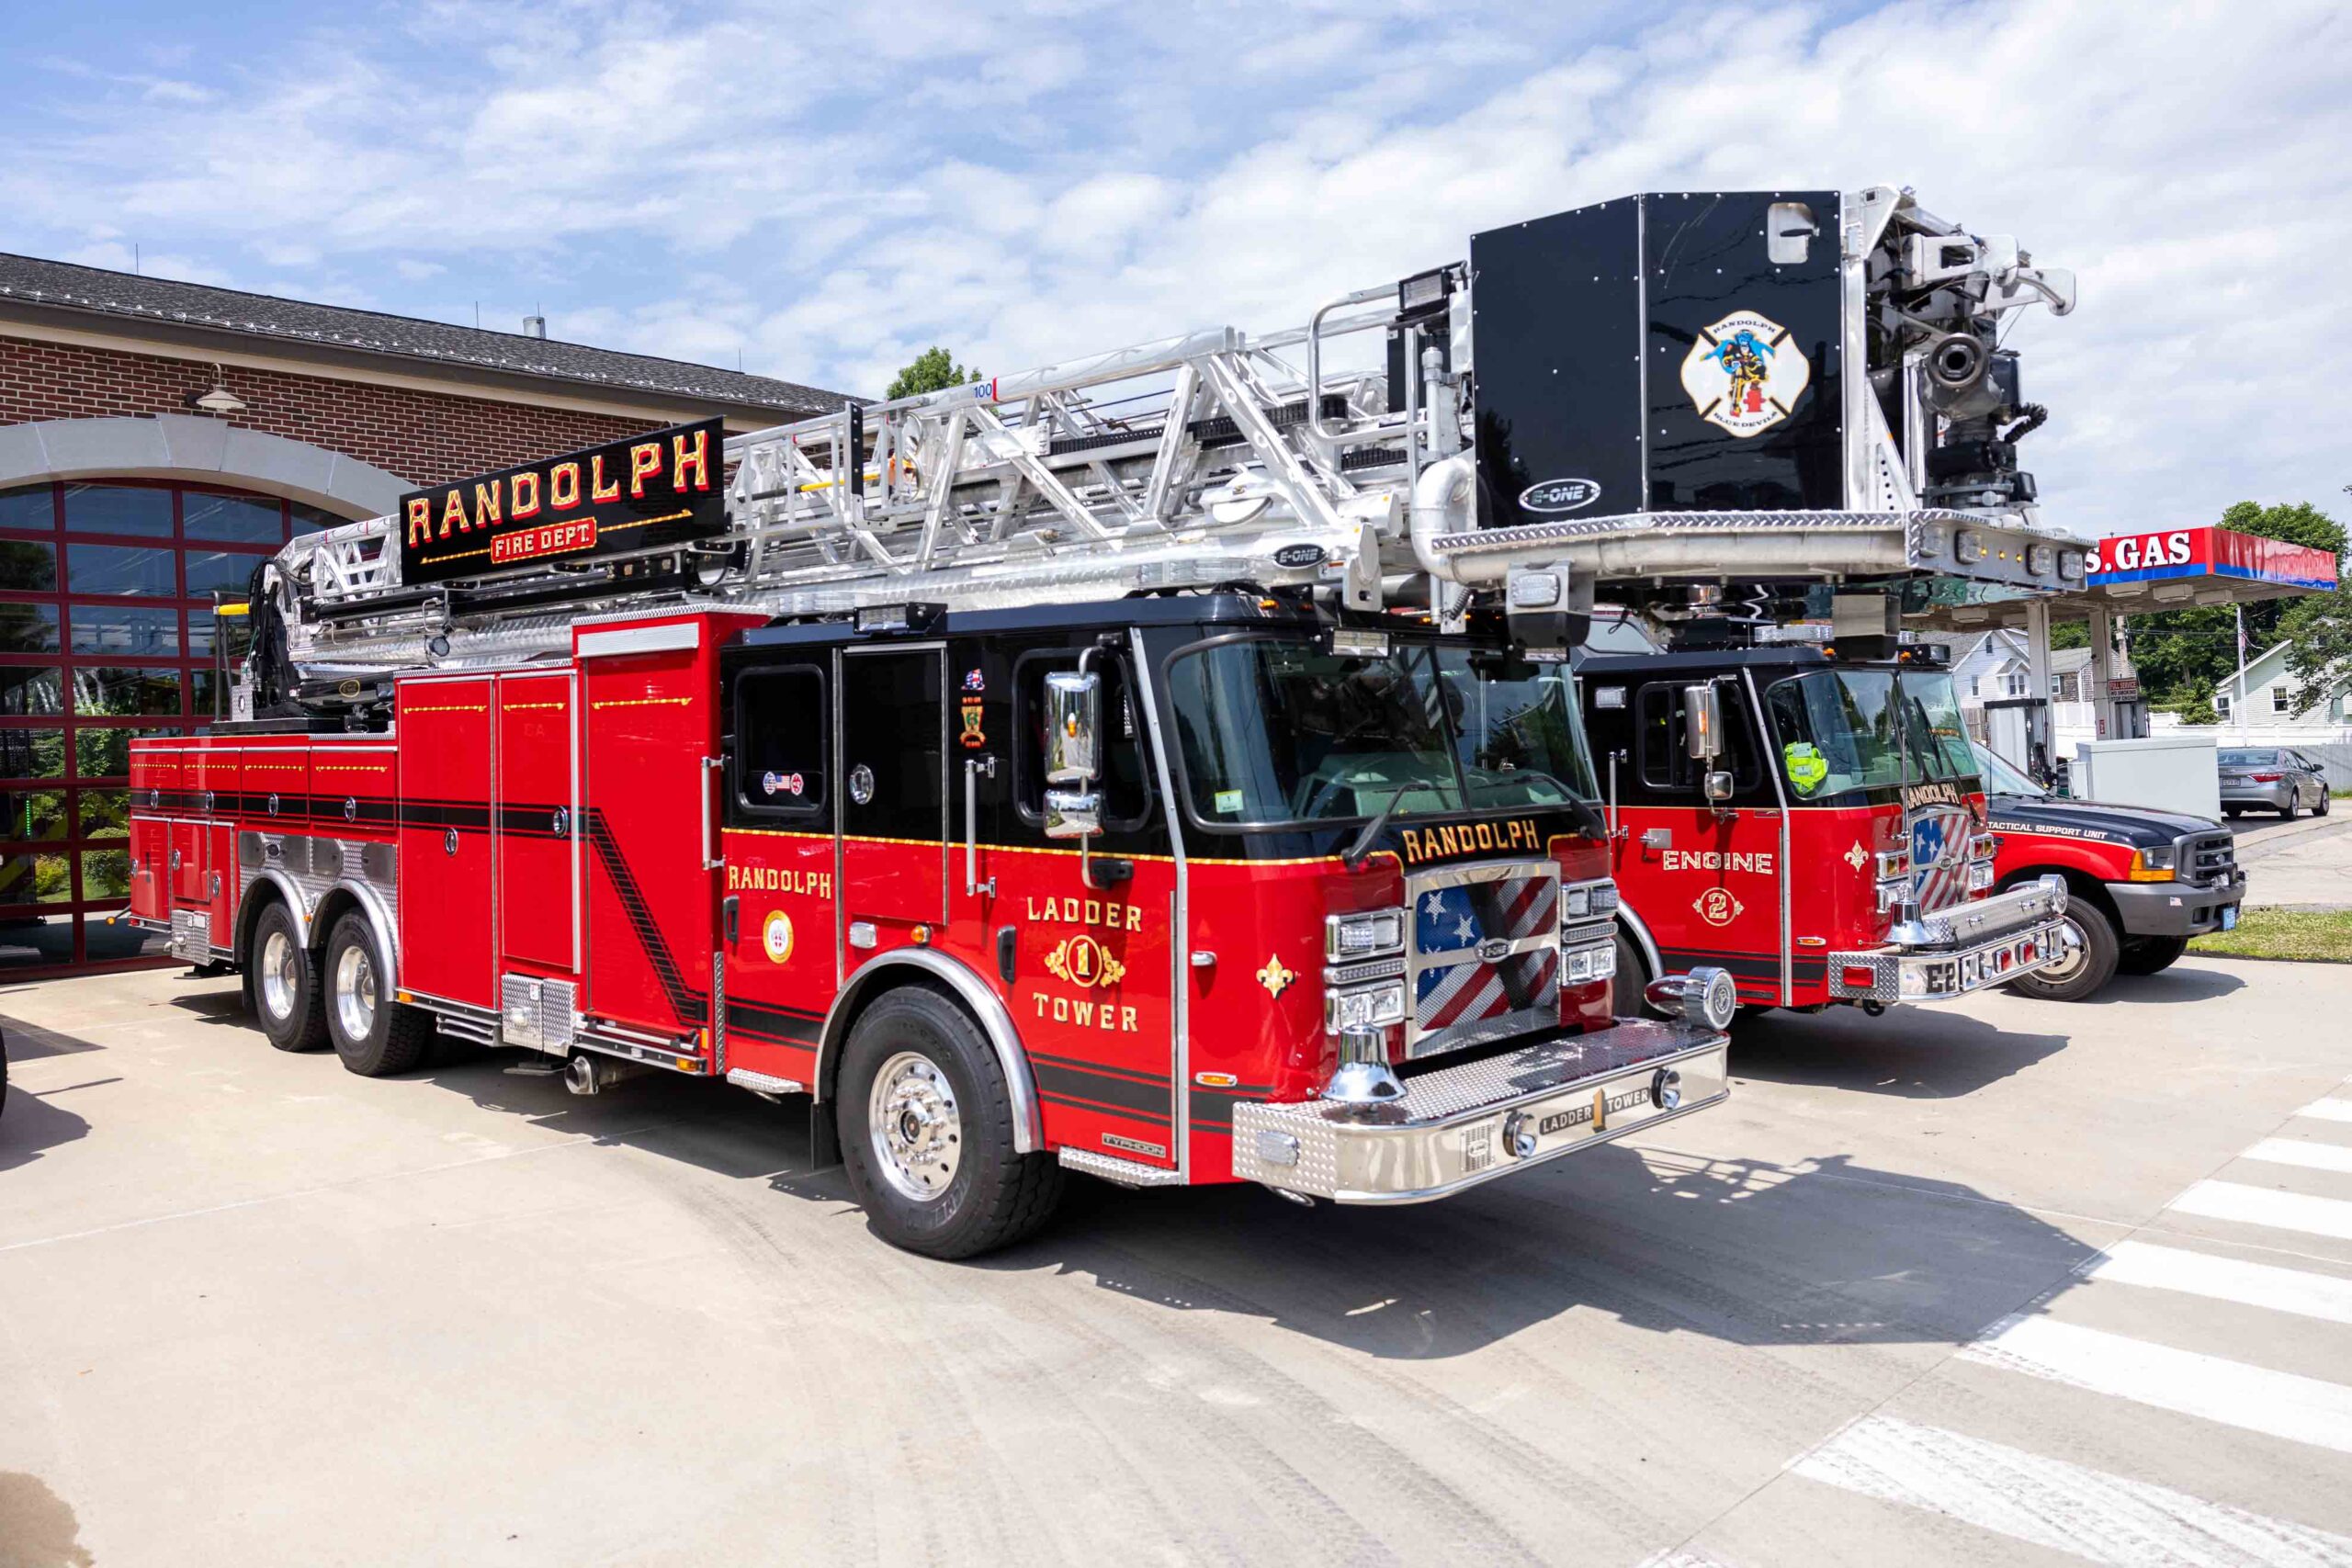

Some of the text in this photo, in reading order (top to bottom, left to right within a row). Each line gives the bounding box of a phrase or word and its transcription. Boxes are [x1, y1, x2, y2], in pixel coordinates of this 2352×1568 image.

[1713, 320, 1777, 334] RANDOLPH
[974, 382, 992, 399] 100
[1713, 412, 1740, 427] BLUE
[407, 429, 709, 547] RANDOLPH
[1531, 484, 1586, 505] E-ONE
[495, 523, 591, 558] FIRE DEPT.
[1279, 547, 1319, 564] E-ONE
[1402, 819, 1541, 864] RANDOLPH
[1987, 820, 2109, 840] TACTICAL SUPPORT UNIT
[1663, 851, 1773, 874] ENGINE
[729, 865, 831, 899] RANDOLPH
[1027, 897, 1142, 932] LADDER
[1708, 892, 1728, 919] 2
[1076, 942, 1091, 976] 1
[1033, 992, 1139, 1032] TOWER
[1543, 1107, 1592, 1134] LADDER
[1607, 1088, 1650, 1112] TOWER
[1103, 1136, 1165, 1156] TYPHOON
